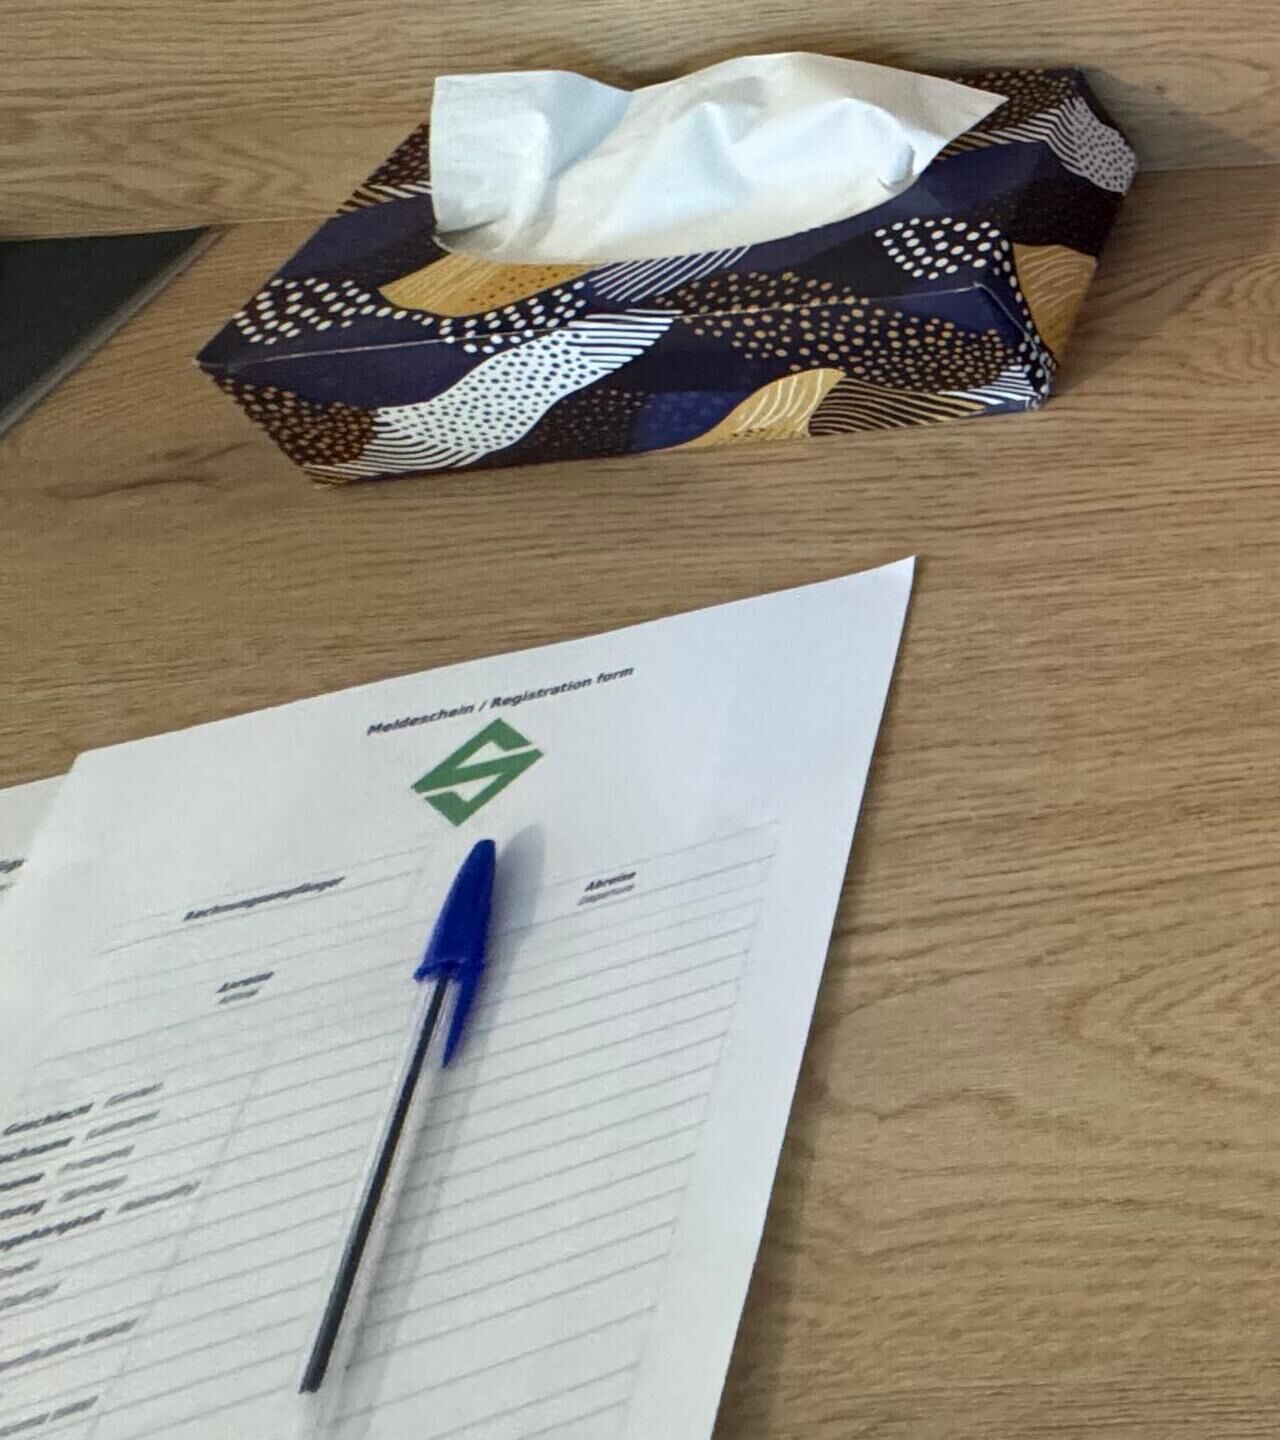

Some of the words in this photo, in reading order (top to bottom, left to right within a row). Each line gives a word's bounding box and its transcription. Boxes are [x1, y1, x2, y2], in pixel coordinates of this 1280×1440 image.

[367, 704, 475, 736] Meldeschein
[478, 700, 487, 712] /
[490, 677, 592, 709] Registration
[596, 667, 635, 683] form
